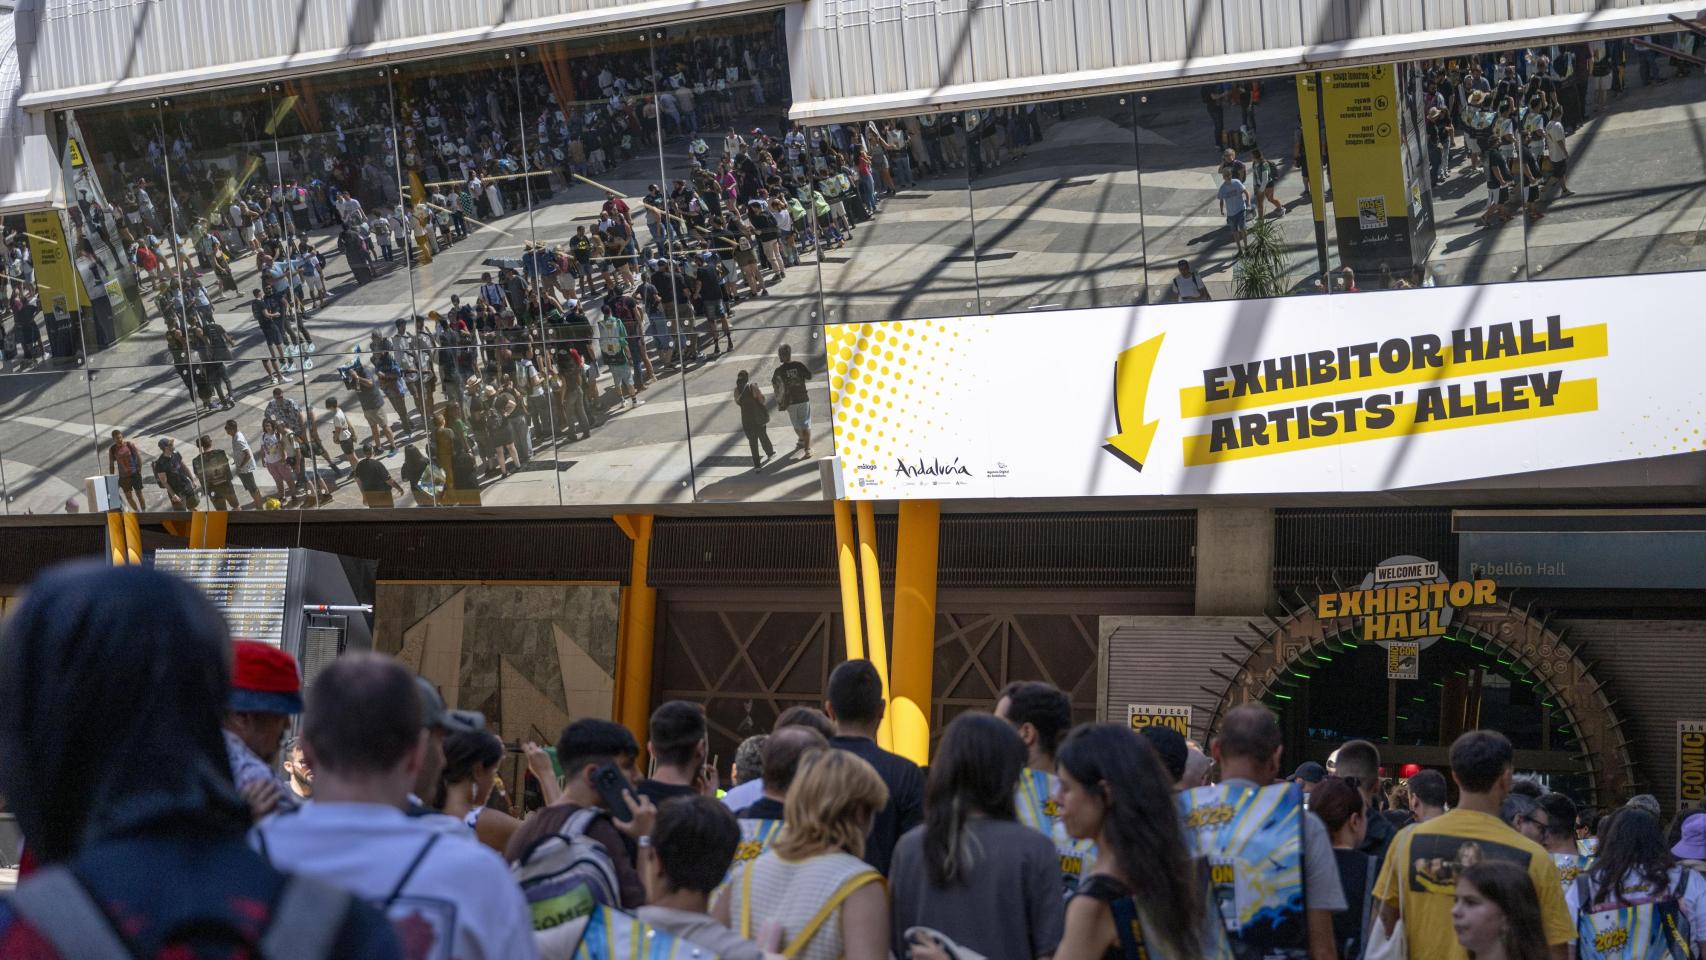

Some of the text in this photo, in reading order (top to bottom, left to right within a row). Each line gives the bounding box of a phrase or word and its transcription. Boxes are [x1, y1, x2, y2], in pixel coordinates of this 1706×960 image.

[1203, 314, 1574, 402] EXHIBITOR HALL
[1209, 370, 1563, 453] ARTISTS' ALLEY
[895, 456, 973, 478] Andalucía
[1378, 564, 1436, 580] WELCOME TO
[1470, 561, 1566, 576] Pabellón Hall
[1318, 579, 1496, 619] EXHIBITOR
[1364, 611, 1447, 641] HALL
[1390, 646, 1399, 673] COMIC
[1399, 646, 1416, 657] CON
[1682, 733, 1705, 800] COMIC
[1060, 856, 1082, 874] ON
[1211, 866, 1234, 883] ON
[1595, 929, 1627, 952] 2025
